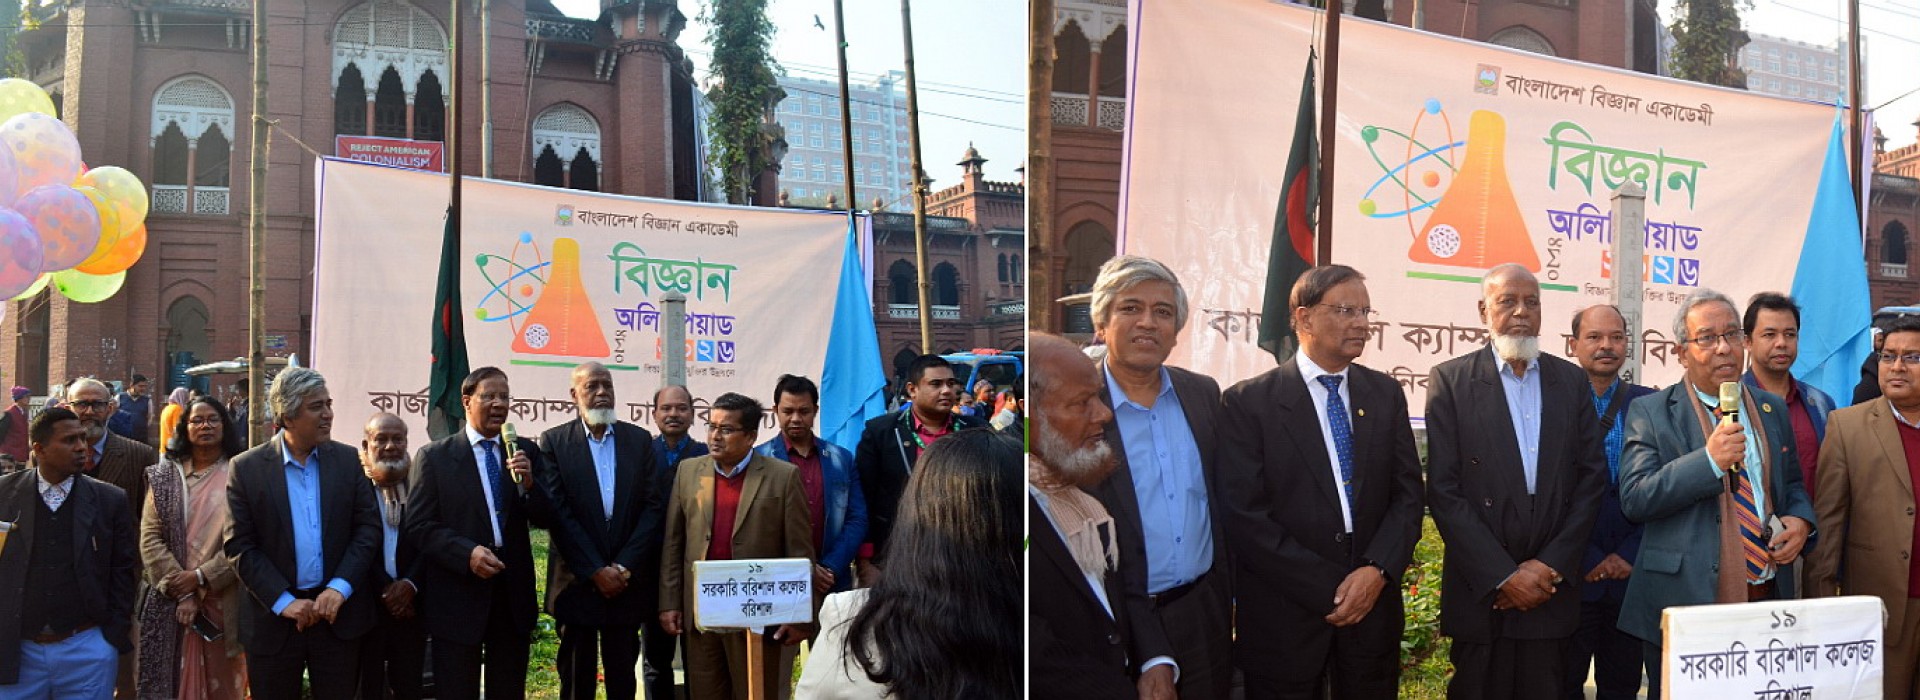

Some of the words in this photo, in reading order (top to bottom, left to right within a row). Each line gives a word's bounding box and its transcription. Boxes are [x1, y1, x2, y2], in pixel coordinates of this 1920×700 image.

[1505, 74, 1586, 104] বাংলাদেশ
[1590, 85, 1642, 113] বিজ্ঞান
[1646, 101, 1714, 126] একাডেমী
[350, 143, 381, 153] REJECT
[383, 146, 431, 155] AMERICAN
[350, 153, 430, 168] COLONIALISM
[1543, 121, 1707, 211] বিজ্ঞান
[578, 209, 638, 228] বাংলাদেশ
[641, 213, 682, 233] বিজ্ঞান
[685, 219, 739, 238] একাডেমী
[607, 241, 737, 304] বিজ্ঞান
[368, 386, 430, 417] কার্জ
[748, 563, 763, 574] ১৯
[702, 578, 738, 597] সরকারি
[740, 577, 775, 596] বরিশাল
[778, 580, 808, 594] কলেজ
[741, 598, 773, 617] বরিশাল
[1770, 609, 1797, 630] ১৯
[1679, 641, 1749, 681] সরকারি
[1755, 638, 1819, 675] বরিশাল
[1824, 639, 1876, 667] কলেজ
